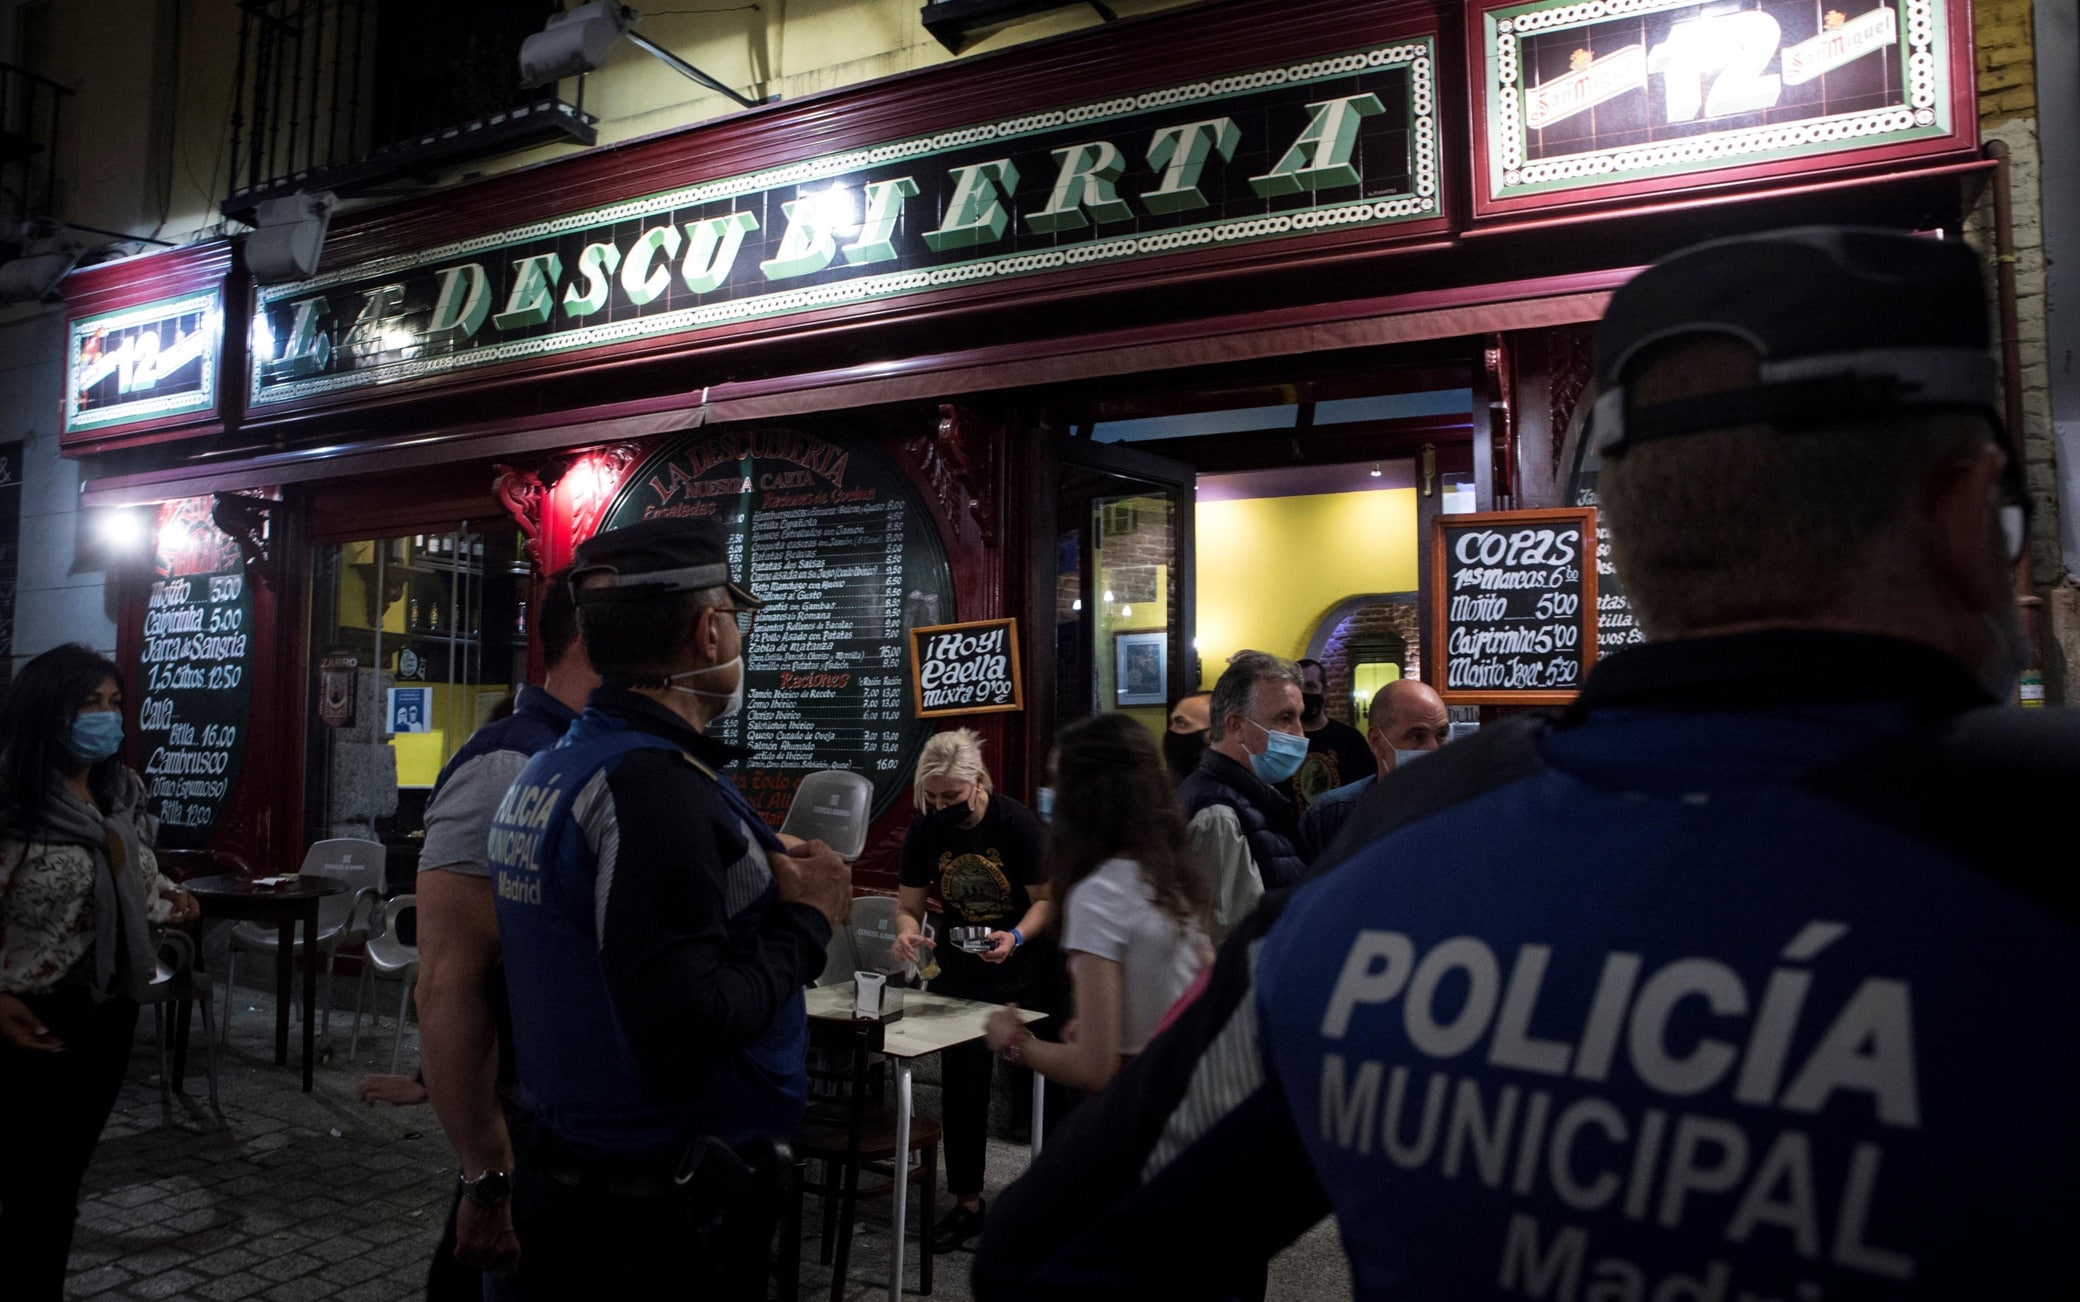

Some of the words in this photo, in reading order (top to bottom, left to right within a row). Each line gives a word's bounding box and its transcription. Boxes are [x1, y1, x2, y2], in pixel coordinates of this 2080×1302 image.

[1787, 46, 1825, 82] San
[1826, 18, 1892, 66] Miguel
[1648, 10, 1782, 122] 12
[1531, 88, 1572, 121] San
[429, 92, 1387, 340] DESCUBIERTA
[116, 331, 161, 394] 12
[649, 462, 691, 505] LA
[684, 476, 755, 499] NUESTRA
[759, 470, 816, 490] CARTA
[751, 551, 784, 562] Patatas
[785, 550, 817, 560] Bravas
[751, 561, 783, 572] Patatas
[798, 559, 826, 569] Salsas
[750, 582, 769, 593] Pisto
[772, 570, 798, 581] asada
[797, 589, 822, 600] Gusto
[802, 601, 836, 611] Gambas
[754, 612, 788, 622] alamares
[797, 610, 831, 621] Romana
[1450, 593, 1508, 622] Mojito
[144, 605, 205, 637] Caipirinha
[786, 621, 816, 631] Rellenos
[761, 632, 781, 642] Pollo
[781, 631, 808, 642] Asado
[823, 630, 853, 641] Patatas
[776, 642, 788, 652] de
[1449, 624, 1537, 660] Caipirinha
[141, 635, 182, 663] Jarra
[149, 663, 173, 693] 1,5
[170, 663, 205, 689] Litros
[780, 671, 851, 690] Raciones
[921, 653, 1007, 690] Paella
[1448, 656, 1505, 688] Mojito
[747, 700, 769, 710] Lomo
[770, 699, 797, 709] Ibérico
[748, 688, 773, 699] Jamón
[774, 689, 800, 699] Ibérico
[923, 684, 975, 708] mixta
[747, 711, 775, 720] Chorizo
[775, 710, 802, 720] Ibérico
[788, 721, 815, 731] Ibérico
[747, 731, 774, 741] Queso
[776, 731, 805, 741] Curado
[814, 731, 836, 742] Oveja
[747, 740, 778, 751] Salmón
[779, 740, 816, 751] Ahumado
[145, 747, 229, 775] Lambrusco
[748, 751, 776, 761] urtido
[176, 777, 229, 801] Espumoso)
[498, 870, 542, 906] Madrid
[1320, 919, 1922, 1130] POLICÍA
[1318, 1053, 1916, 1280] MUNICIPAL
[1496, 1213, 1826, 1302] Mad
